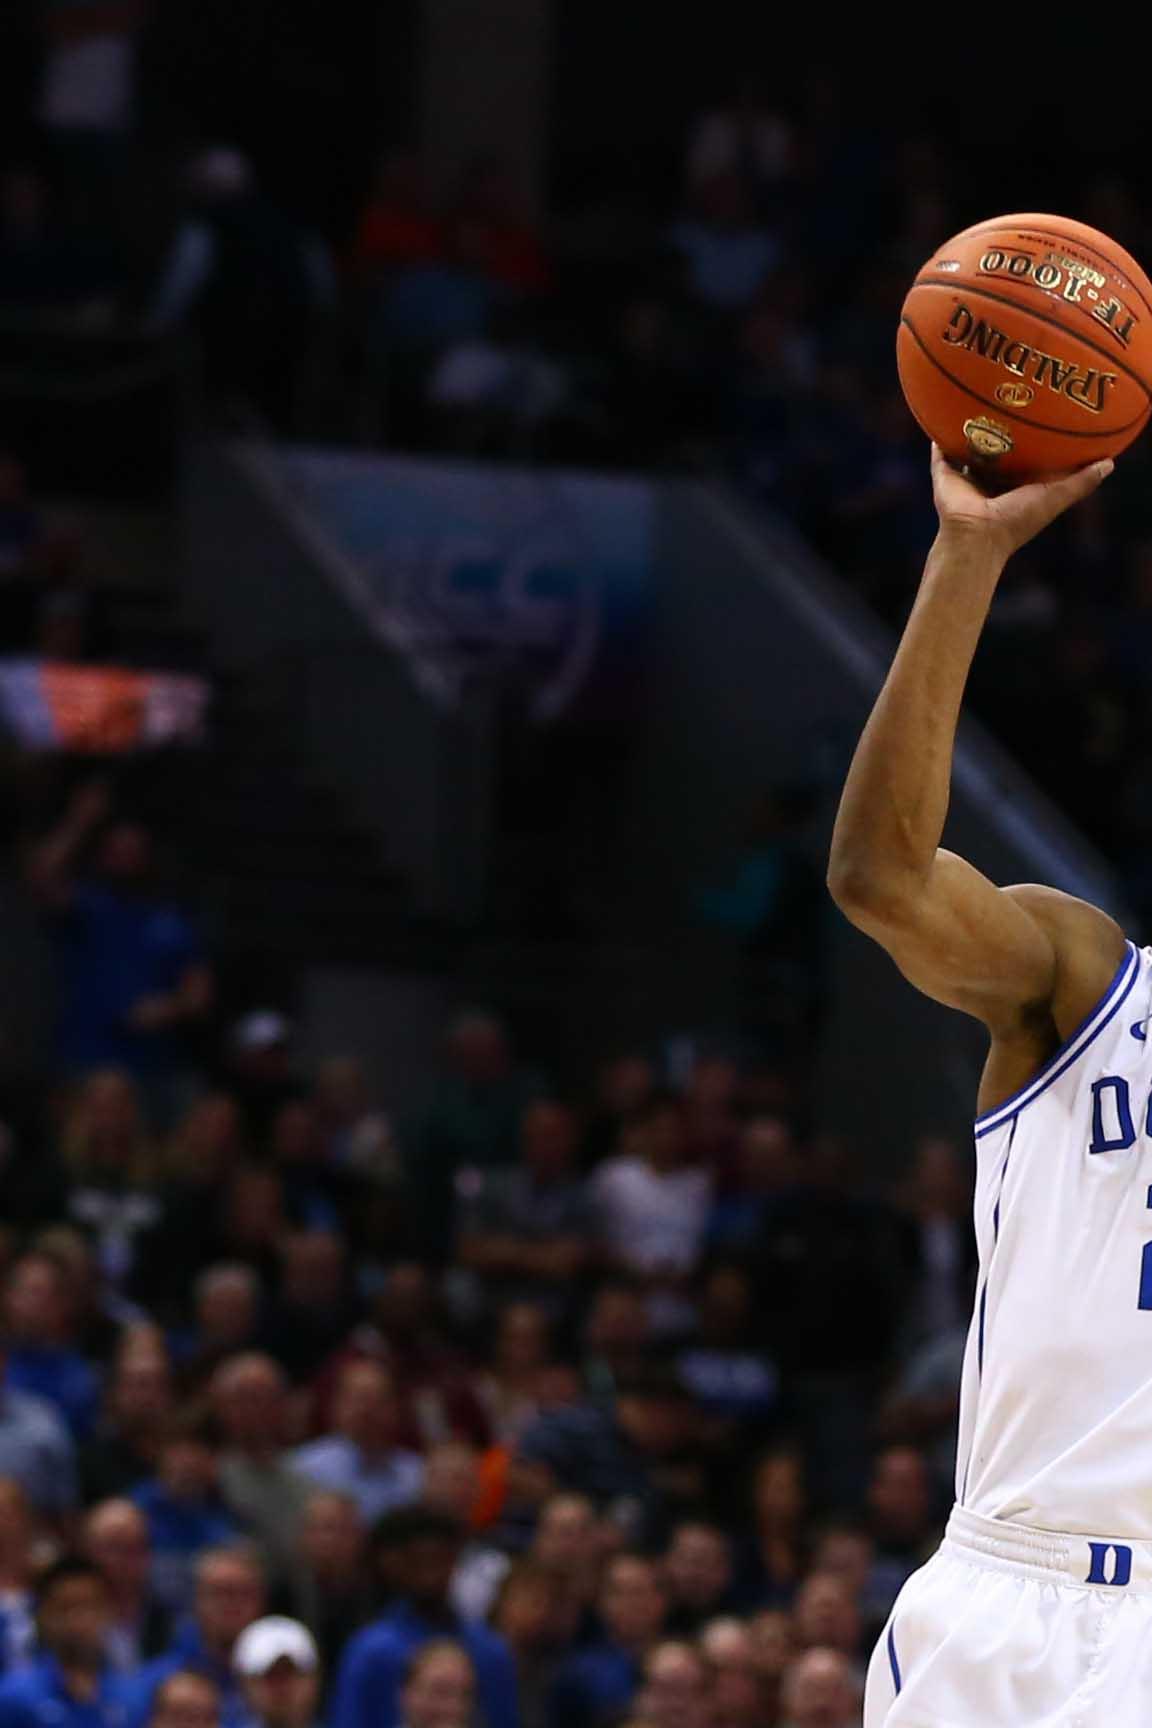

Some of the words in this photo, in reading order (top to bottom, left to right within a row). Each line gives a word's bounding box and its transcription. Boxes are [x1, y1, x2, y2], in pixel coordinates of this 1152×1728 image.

[980, 250, 1138, 346] TF-1000
[943, 303, 1118, 414] SPALDING
[1084, 1541, 1133, 1587] D
